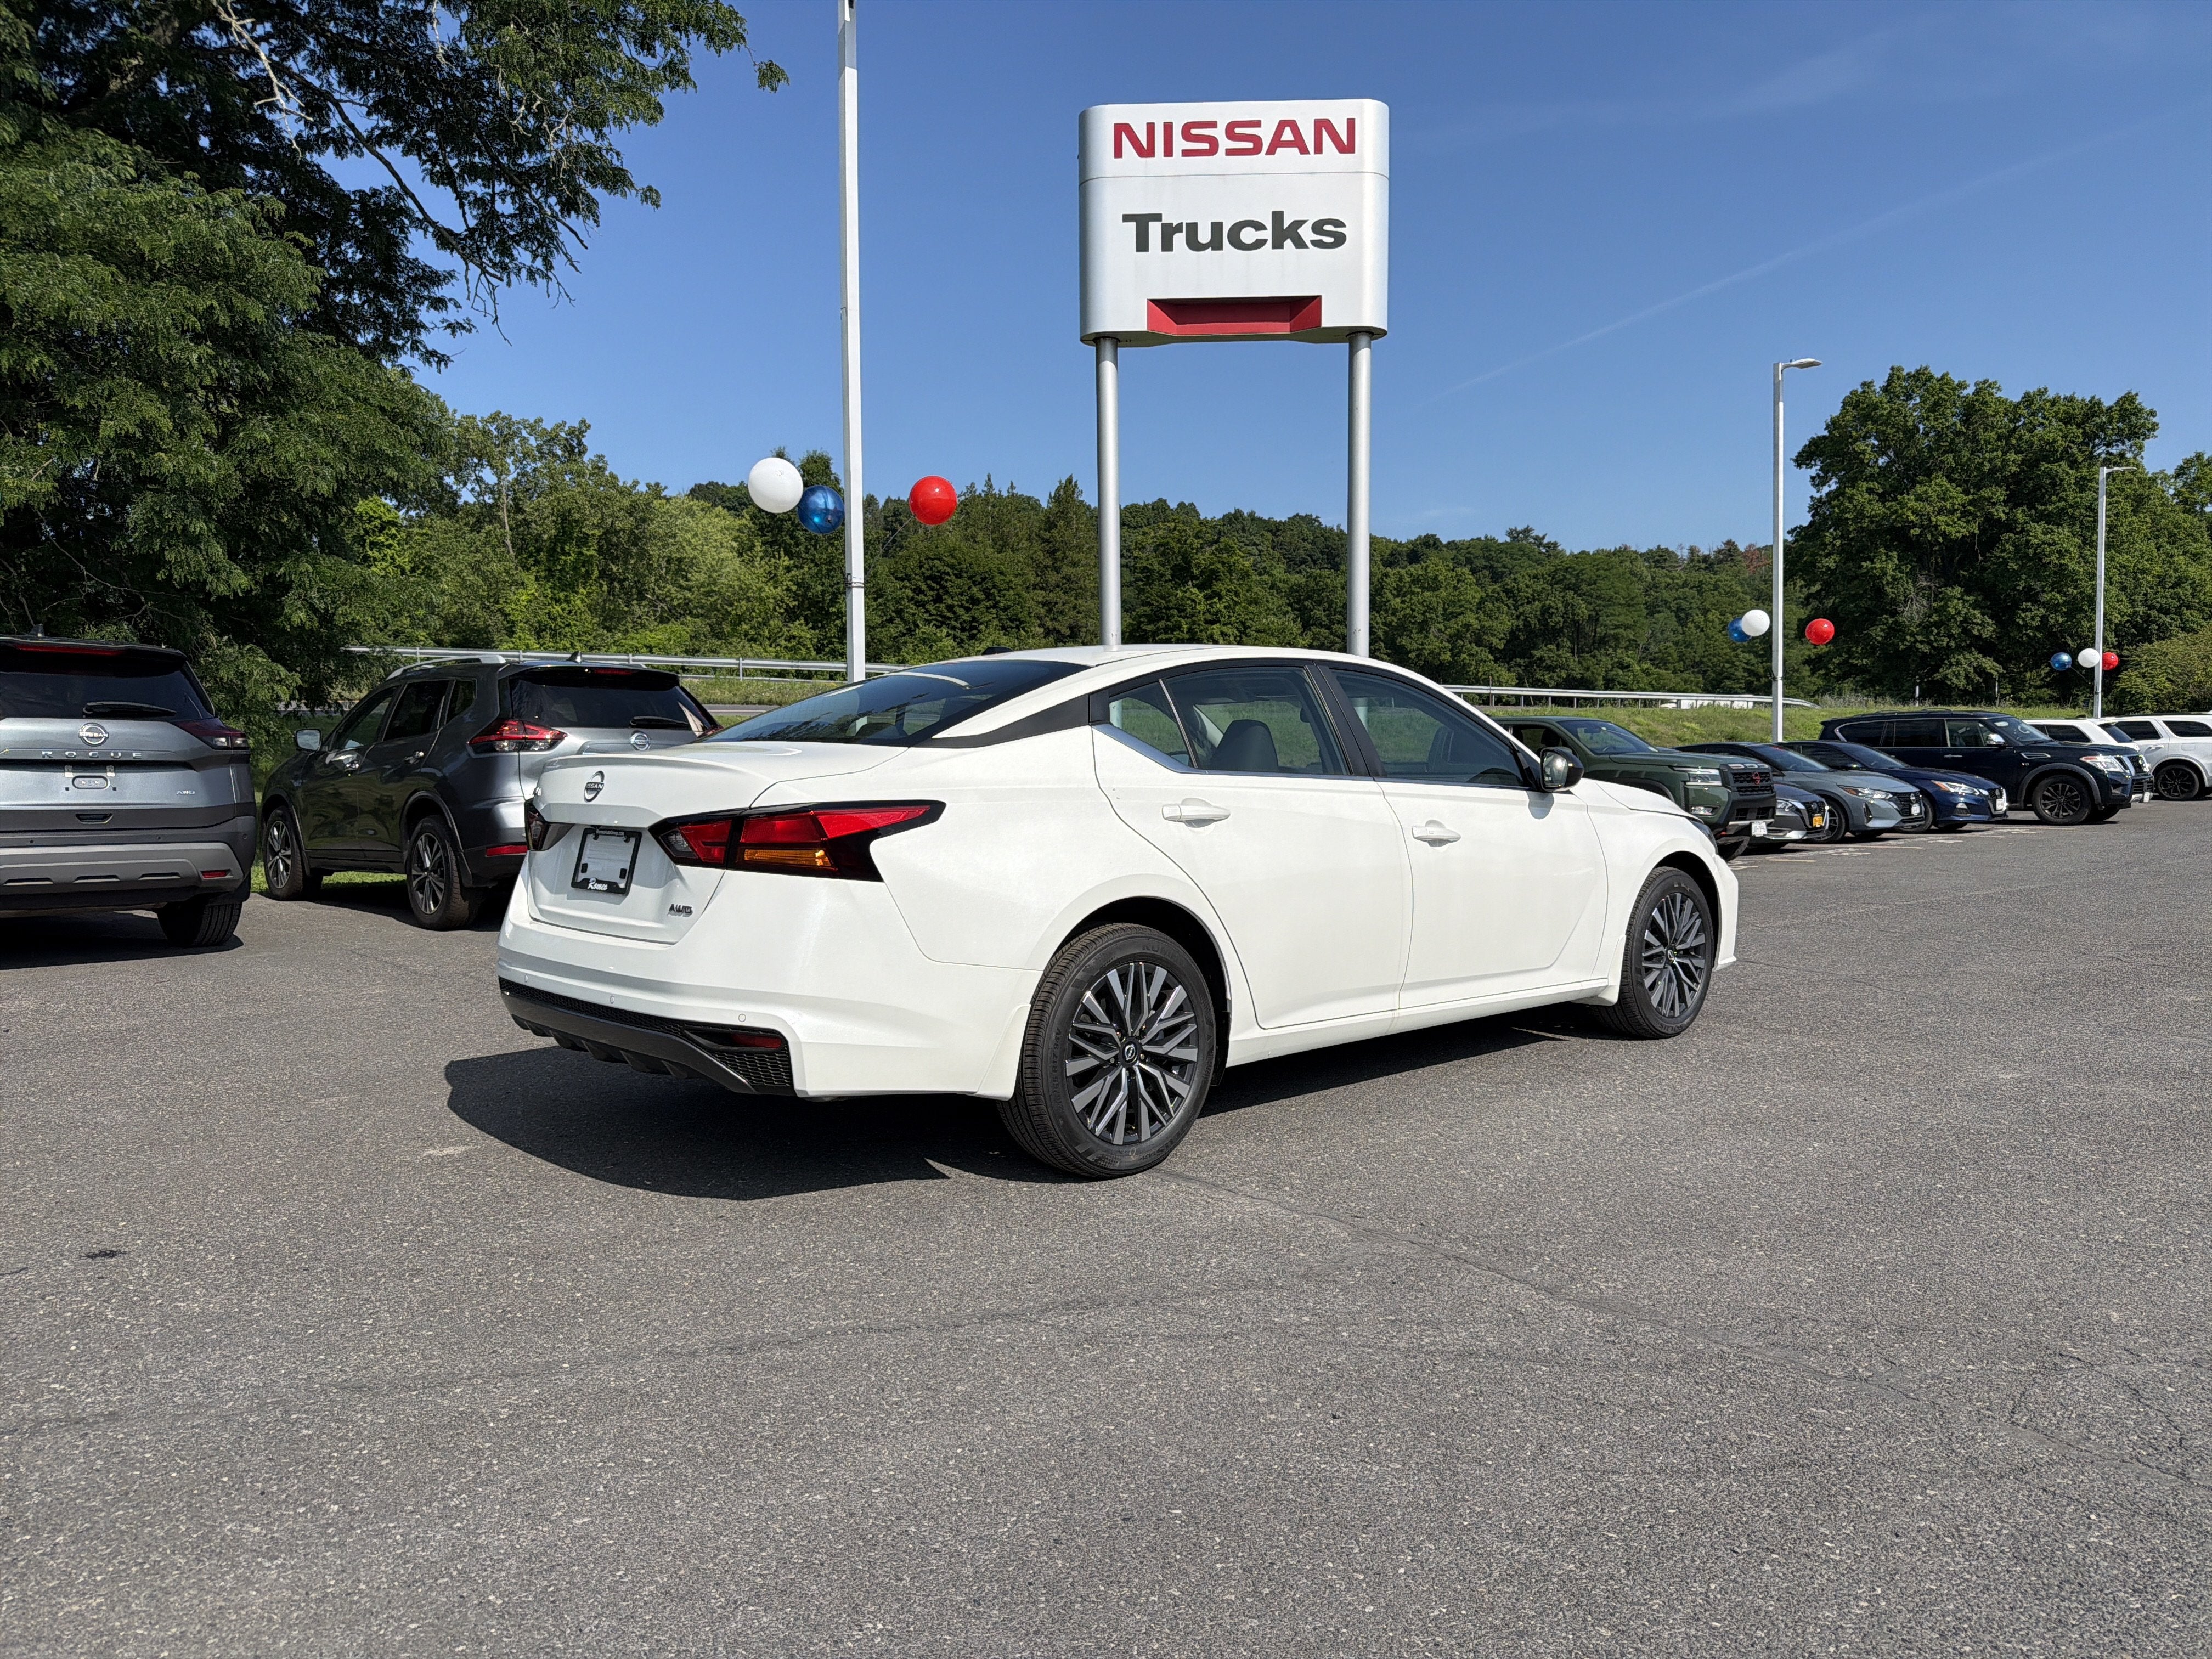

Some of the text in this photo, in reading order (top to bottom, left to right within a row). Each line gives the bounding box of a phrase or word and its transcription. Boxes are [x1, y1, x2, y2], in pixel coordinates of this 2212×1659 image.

[1113, 118, 1356, 159] NISSAN
[1122, 210, 1347, 253] Trucks
[668, 904, 693, 915] AWD
